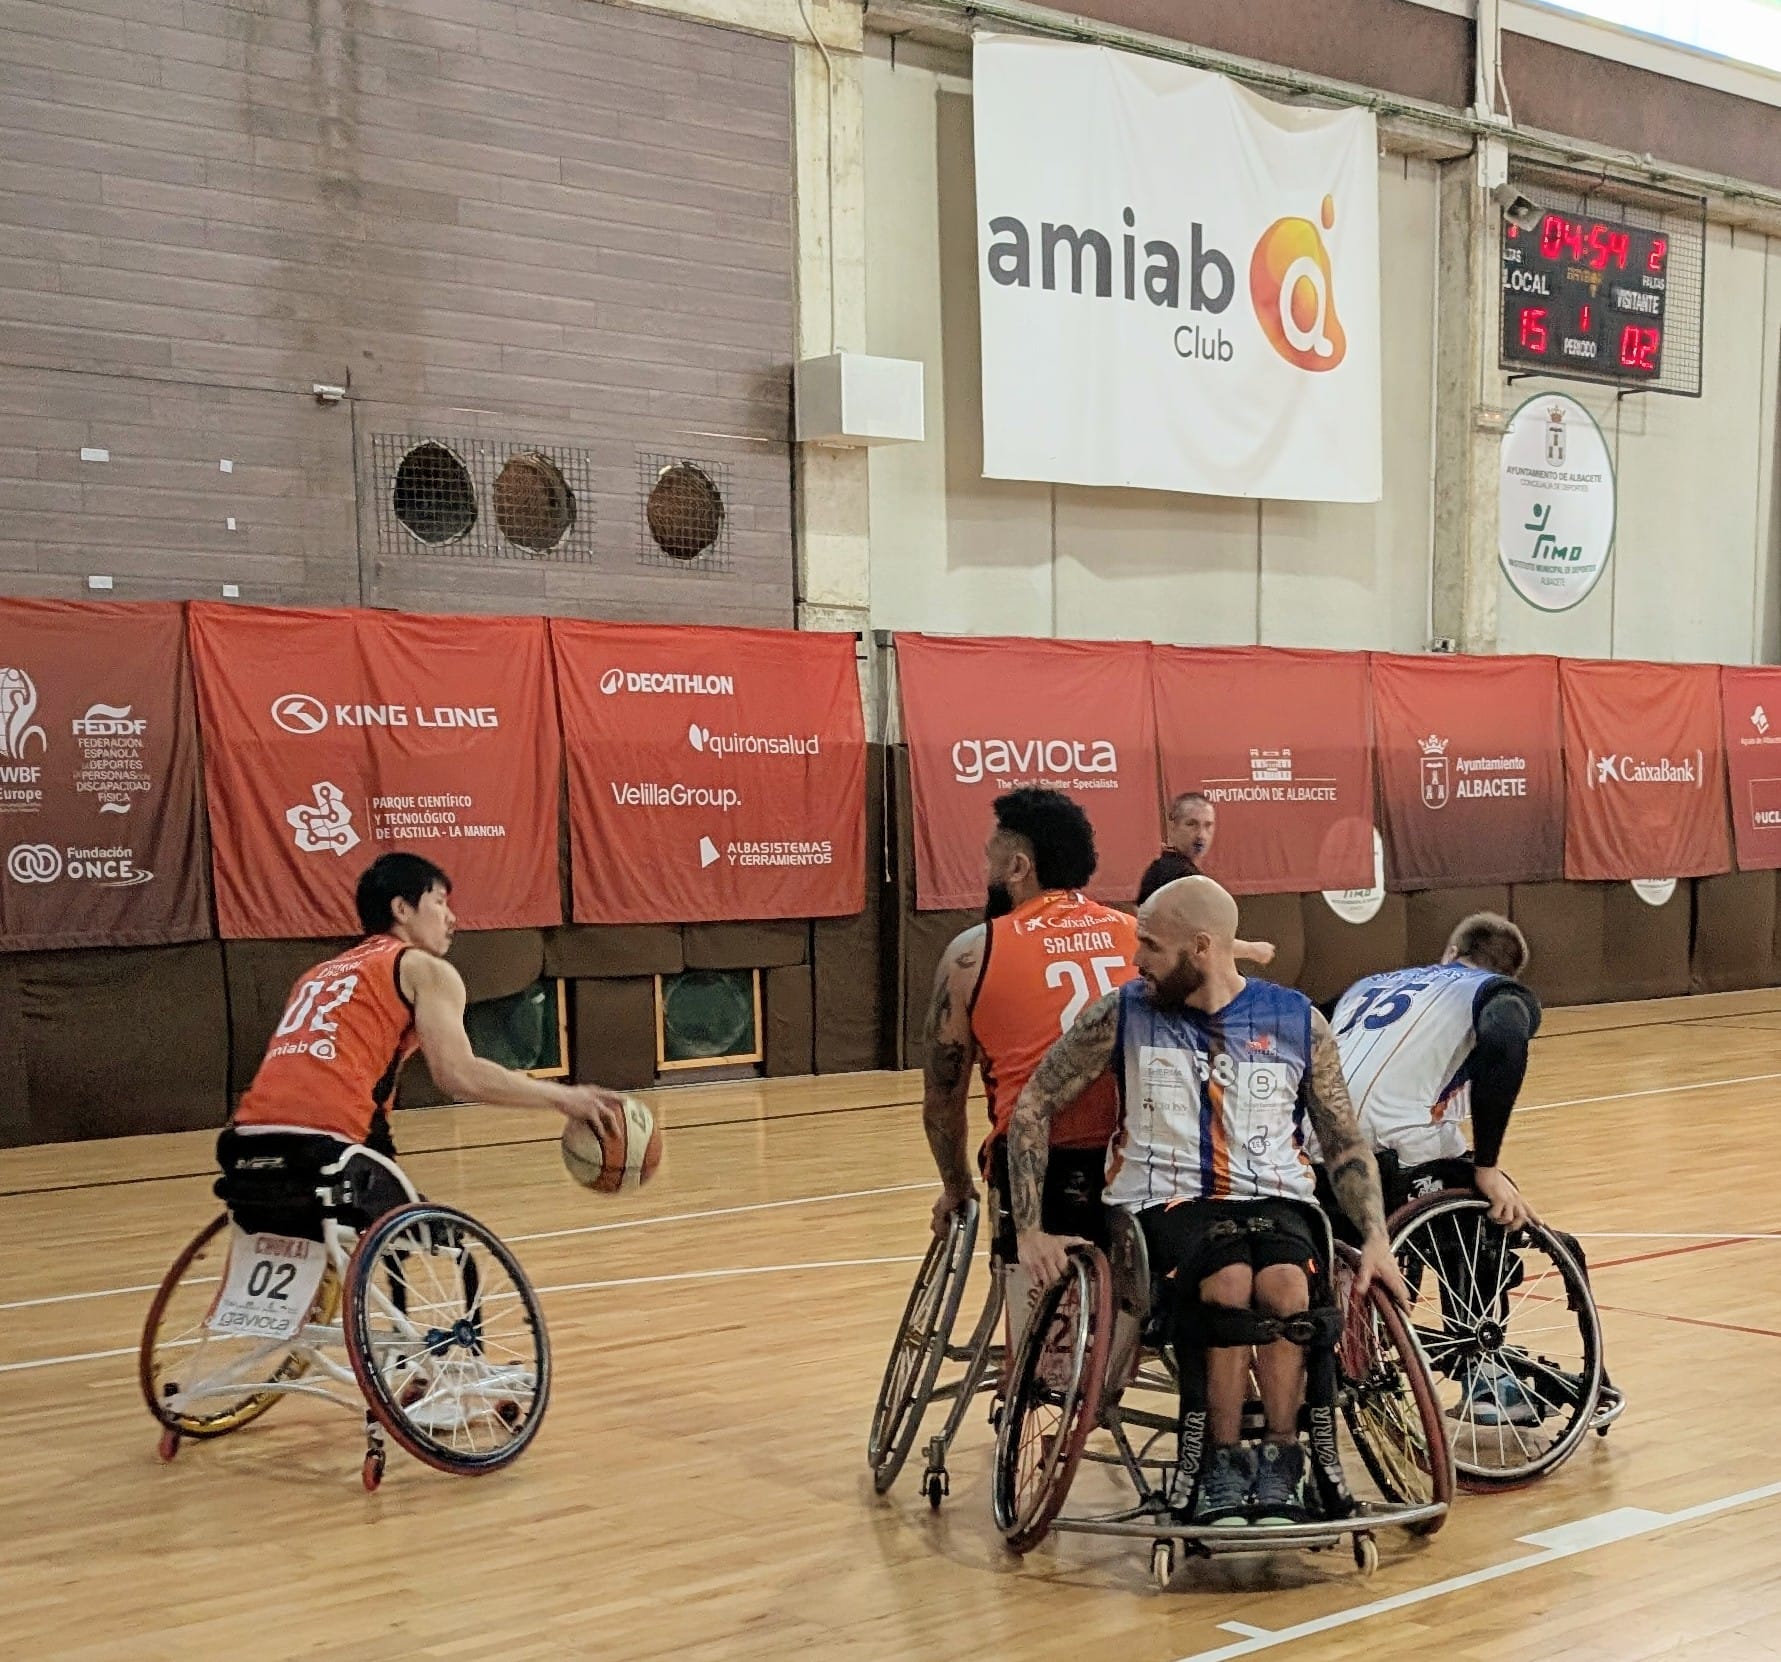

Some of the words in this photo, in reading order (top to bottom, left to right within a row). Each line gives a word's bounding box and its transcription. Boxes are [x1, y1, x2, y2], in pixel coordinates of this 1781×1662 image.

[988, 206, 1235, 315] amiab
[1649, 240, 1666, 270] 2
[1503, 269, 1550, 296] LOCAL
[1616, 289, 1660, 315] VISITANTE
[1174, 325, 1234, 362] Club
[1620, 324, 1660, 368] 02
[1506, 466, 1557, 480] AYUNTAMIENTO
[1559, 472, 1568, 481] DE
[1569, 474, 1602, 483] ALBACETE
[627, 673, 733, 694] DECATHLON
[335, 704, 408, 726] KING
[416, 706, 498, 727] LONG
[72, 719, 147, 735] FEDDF
[952, 739, 1118, 784] gaviota
[1456, 756, 1526, 773] Ayuntamiento
[1620, 756, 1695, 783] CaixaBank
[76, 781, 151, 792] DISCAPACIDAD
[997, 779, 1012, 789] The
[1073, 778, 1119, 790] Specialists
[1271, 787, 1285, 800] DE
[1287, 787, 1336, 800] ALBACETE
[1456, 779, 1526, 798] ALBACETE
[373, 796, 415, 809] PARQUE
[418, 793, 472, 808] CIENTÍFICO
[374, 815, 381, 825] Y
[384, 811, 456, 825] TECNOLÓGICO
[376, 827, 391, 840] DE
[394, 826, 440, 838] CASTILLA
[450, 826, 462, 838] LA
[464, 825, 506, 837] MANCHA
[67, 847, 133, 859] Fundación
[727, 841, 832, 853] ALBASISTEMAS
[728, 855, 735, 865] Y
[740, 853, 832, 866] CERRAMIENTOS
[67, 861, 133, 879] ONCE
[1043, 932, 1116, 954] SALAZAR
[276, 975, 358, 1037] 02
[1337, 983, 1430, 1037] 15
[247, 1260, 297, 1300] 02
